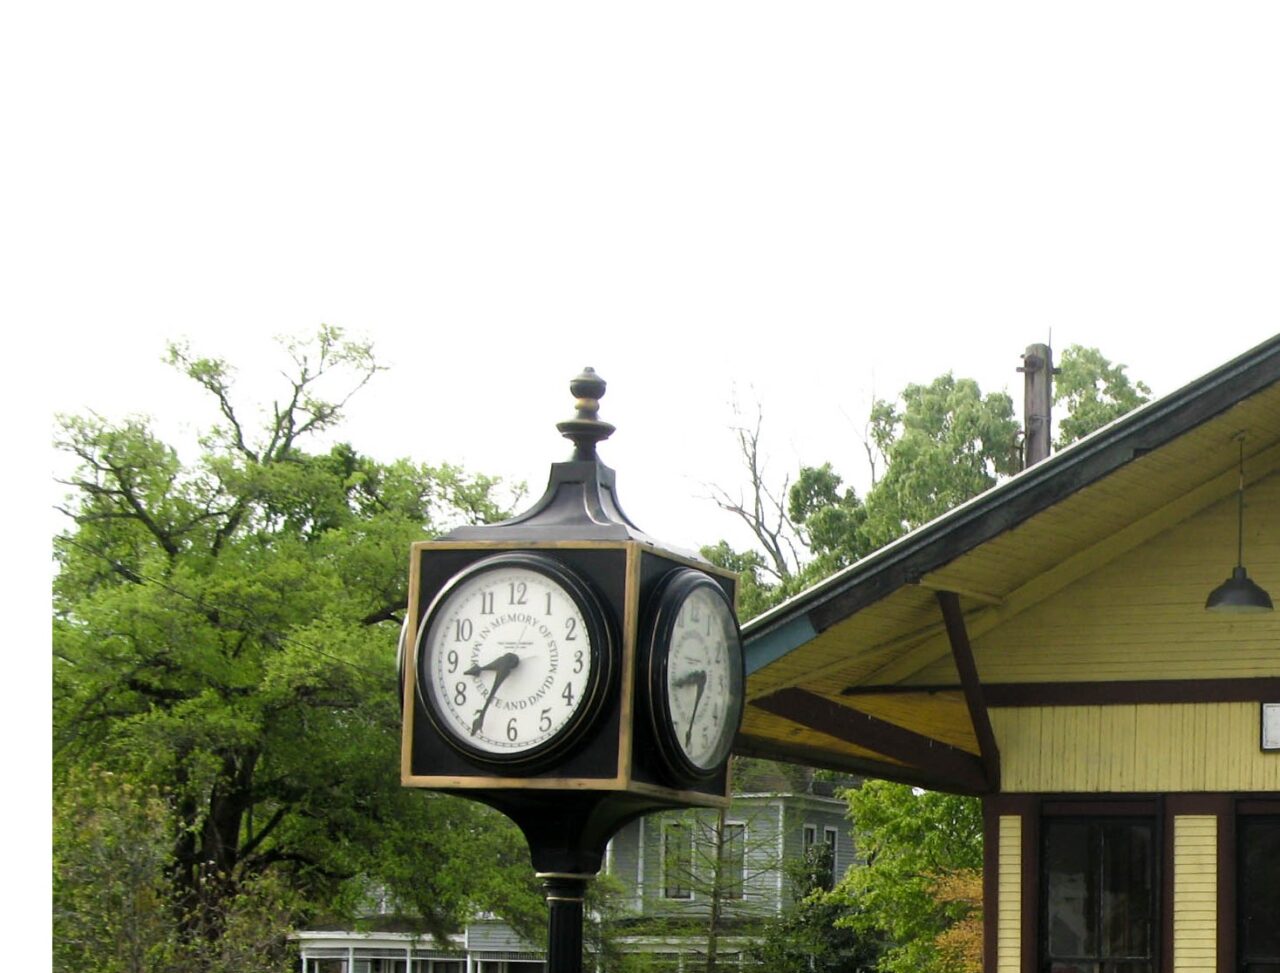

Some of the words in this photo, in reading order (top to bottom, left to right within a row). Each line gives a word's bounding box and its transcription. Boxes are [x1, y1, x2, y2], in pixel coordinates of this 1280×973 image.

[480, 592, 494, 615] 11
[508, 582, 527, 605] 12
[545, 592, 552, 616] 1
[454, 618, 473, 642] 10
[479, 626, 491, 640] IN
[490, 613, 541, 629] MEMORY
[539, 625, 553, 640] OF
[565, 618, 576, 641] 2
[447, 650, 458, 674] 9
[573, 650, 583, 674] 3
[454, 682, 467, 706] 8
[502, 699, 527, 712] AND
[528, 675, 555, 706] DAVID
[562, 682, 574, 706] 4
[506, 717, 518, 741] 6
[539, 708, 552, 733] 5
